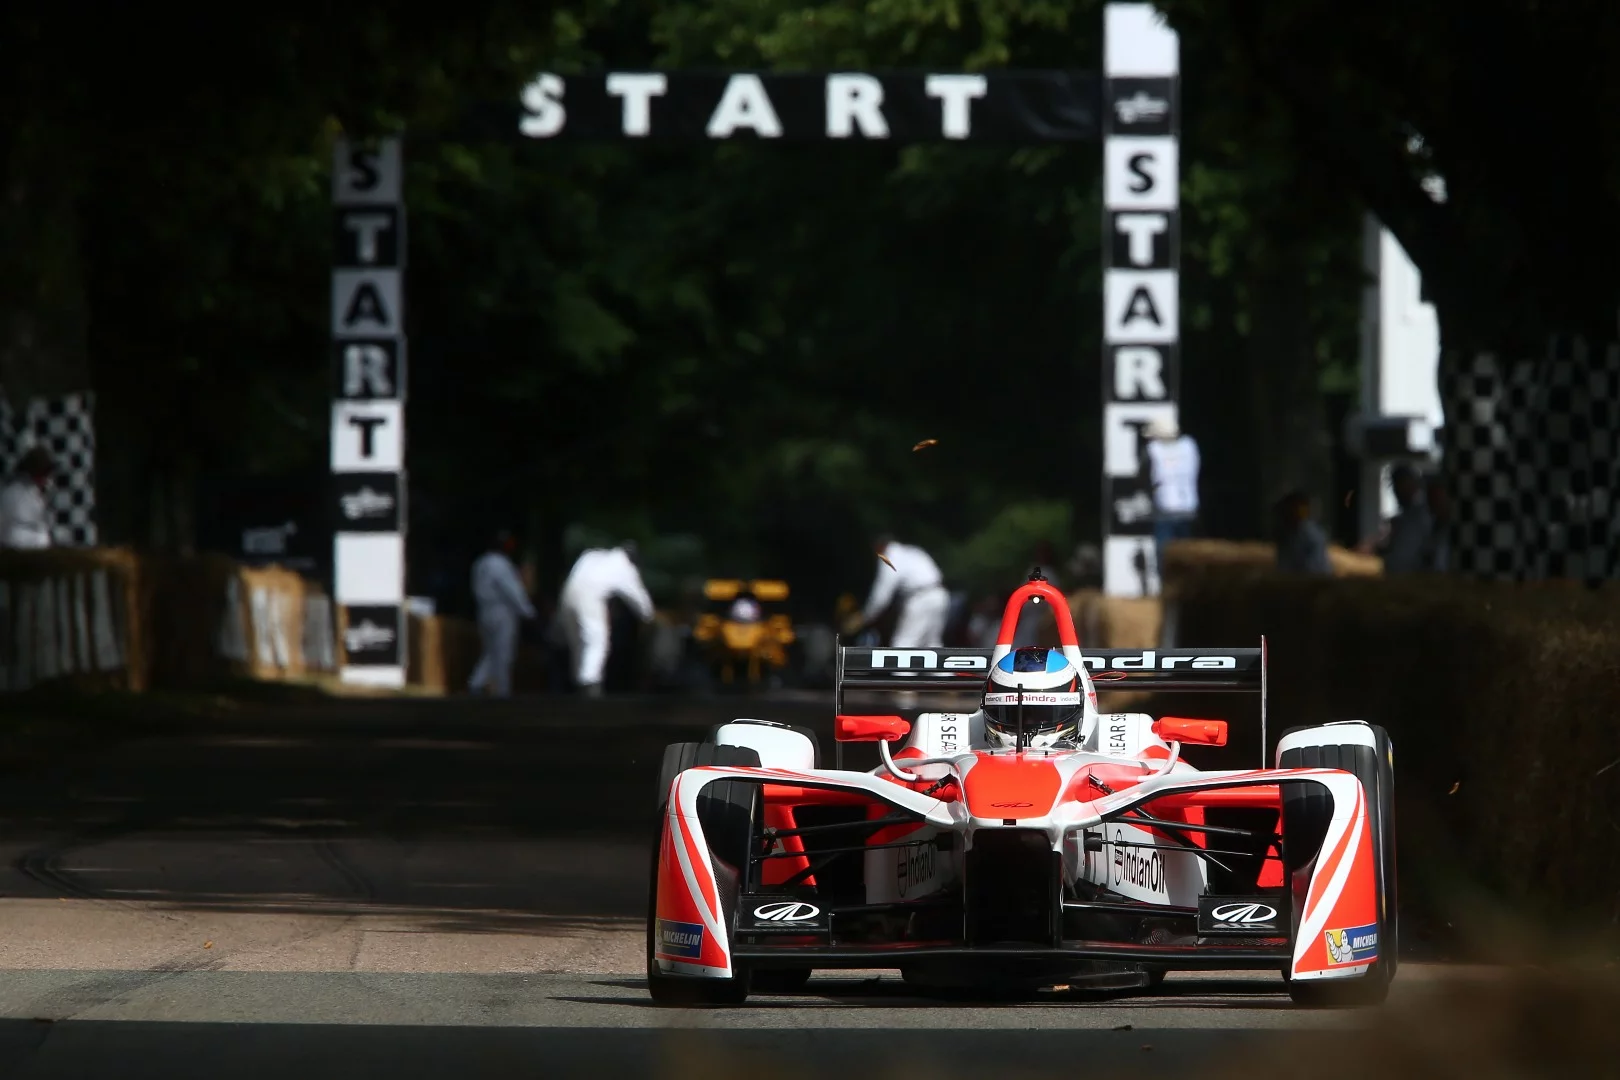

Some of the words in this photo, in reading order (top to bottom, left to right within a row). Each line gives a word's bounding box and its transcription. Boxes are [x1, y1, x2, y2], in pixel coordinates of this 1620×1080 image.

[519, 73, 987, 138] START
[343, 149, 392, 458] START
[1123, 846, 1166, 894] IndianOil
[663, 930, 701, 946] MICHELIN
